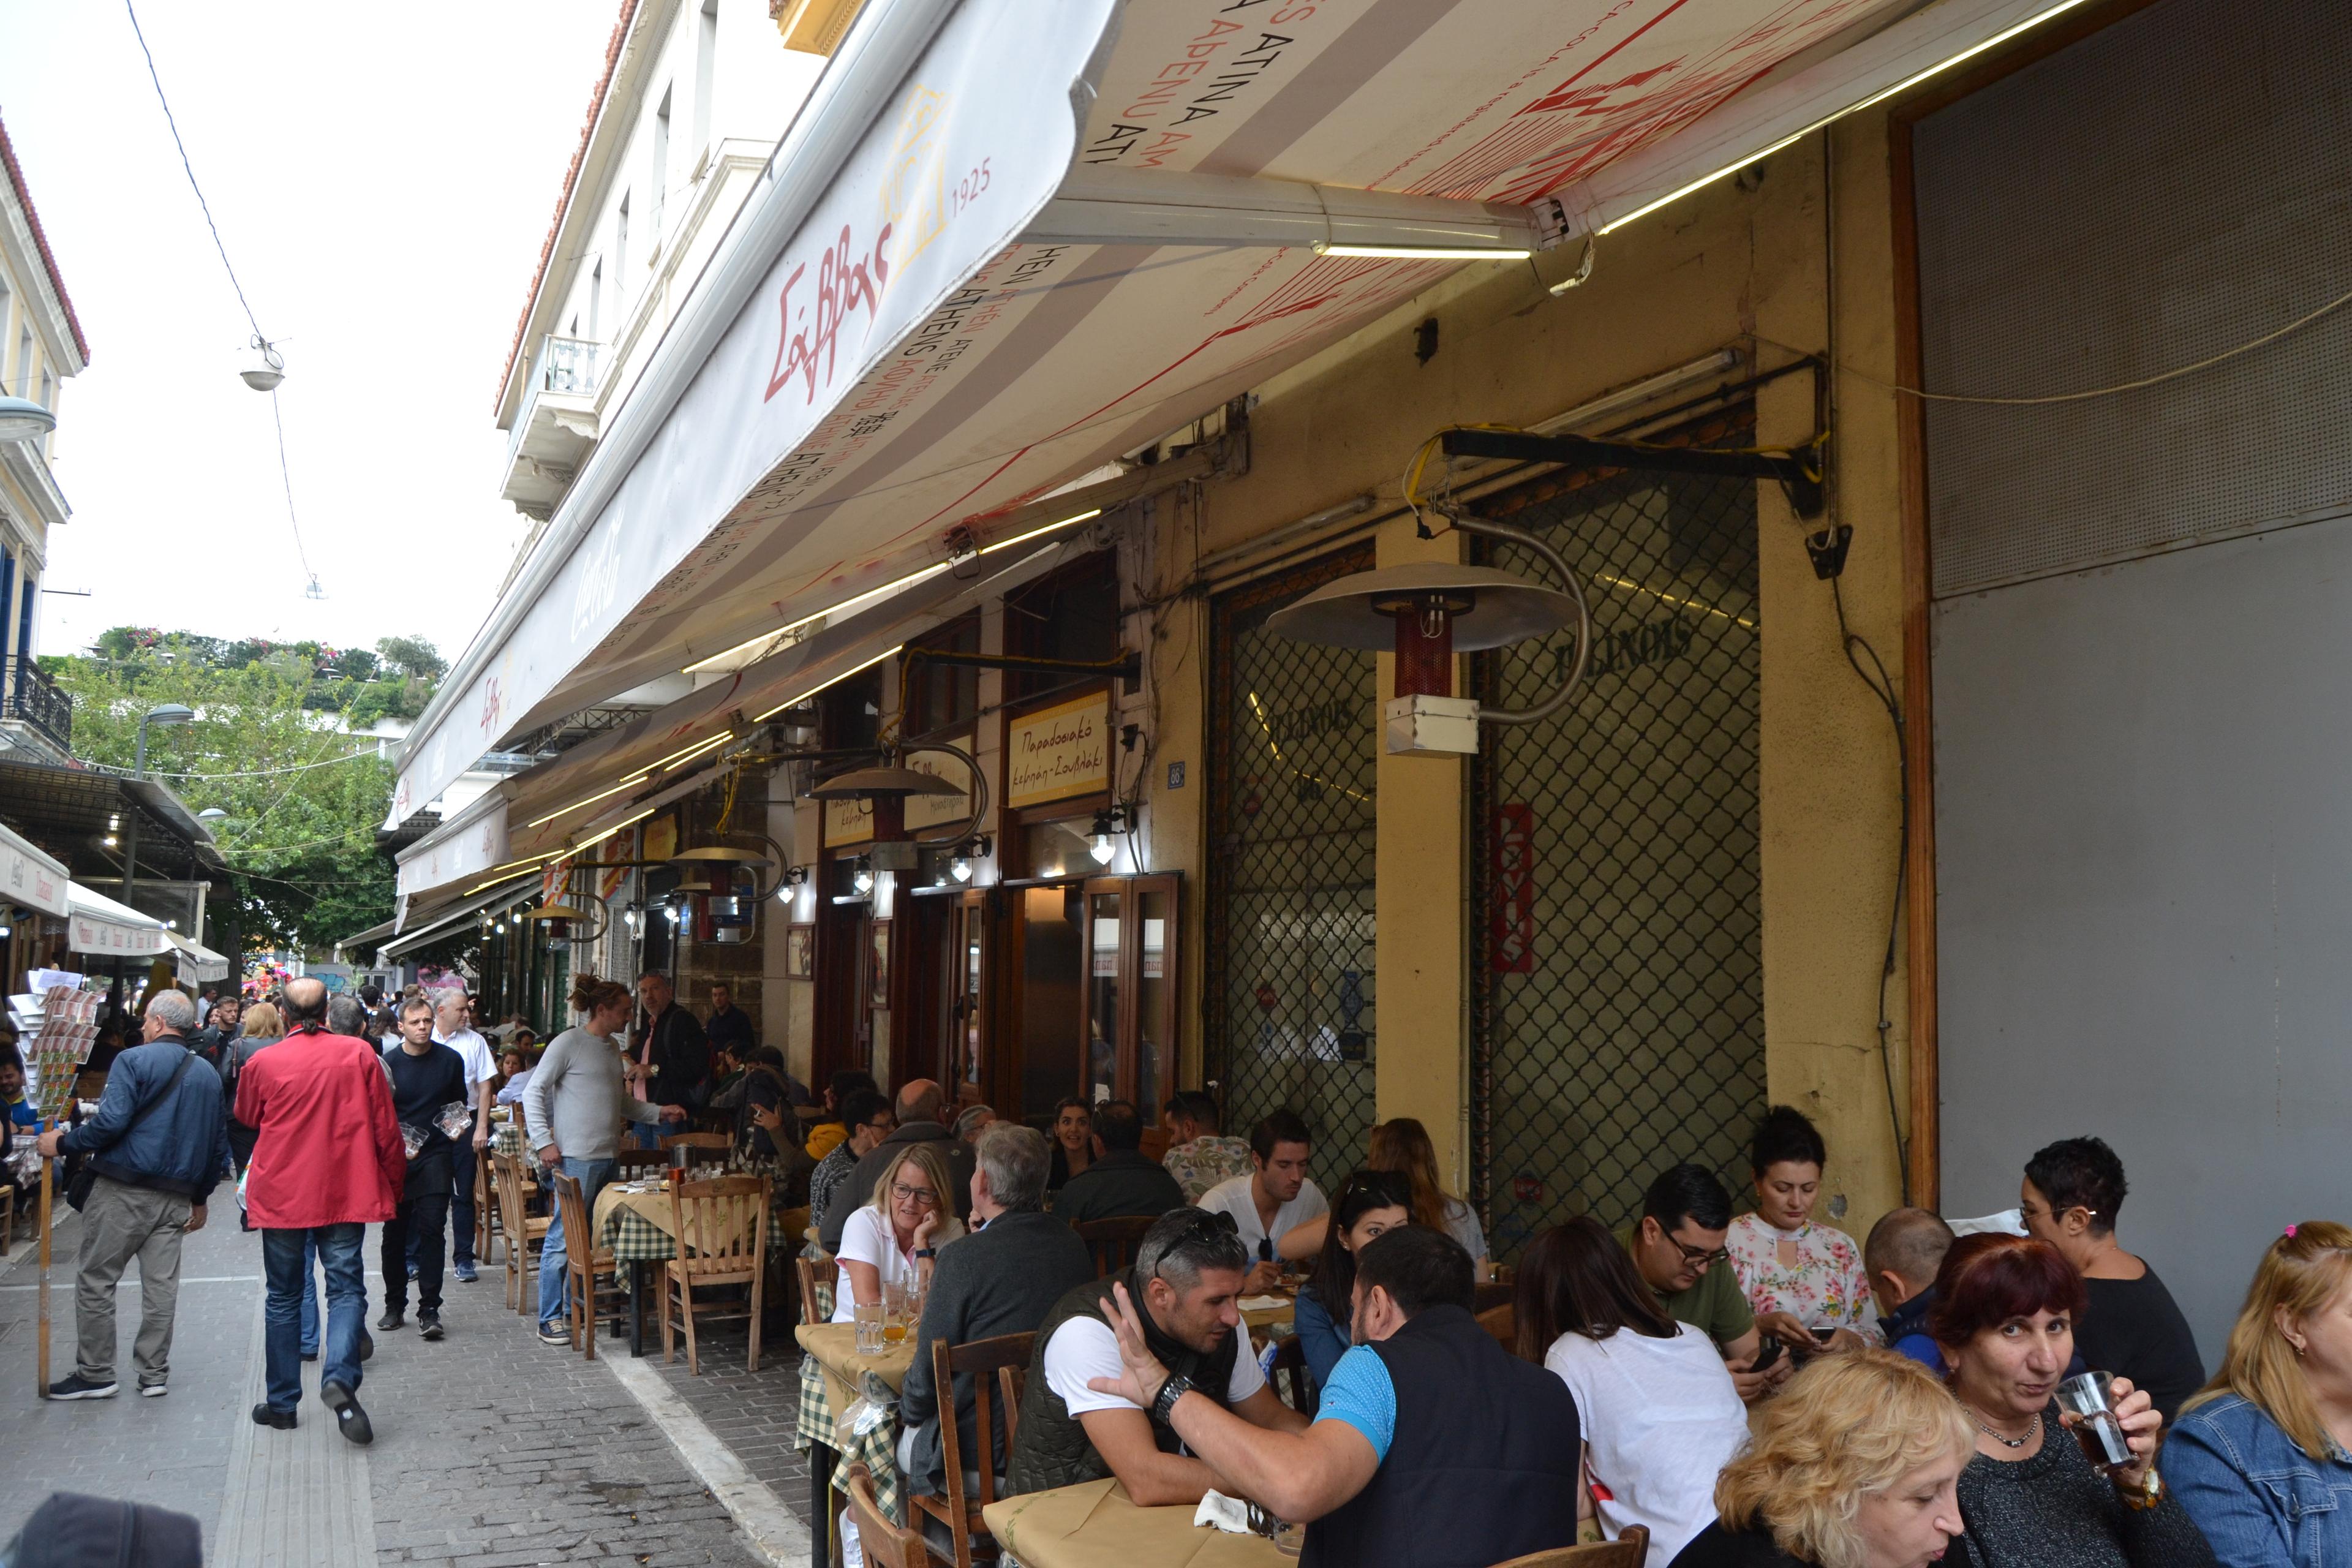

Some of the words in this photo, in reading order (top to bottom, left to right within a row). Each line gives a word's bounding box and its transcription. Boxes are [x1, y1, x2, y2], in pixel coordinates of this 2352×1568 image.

[1168, 32, 1294, 127] ATINA
[952, 156, 990, 218] 1925
[903, 288, 990, 356] ATHENS
[924, 339, 973, 374] ATENE
[888, 375, 938, 410] ATENAS
[841, 410, 899, 439] 雅典
[747, 453, 826, 499] ATHENS
[1170, 767, 1180, 785] 86
